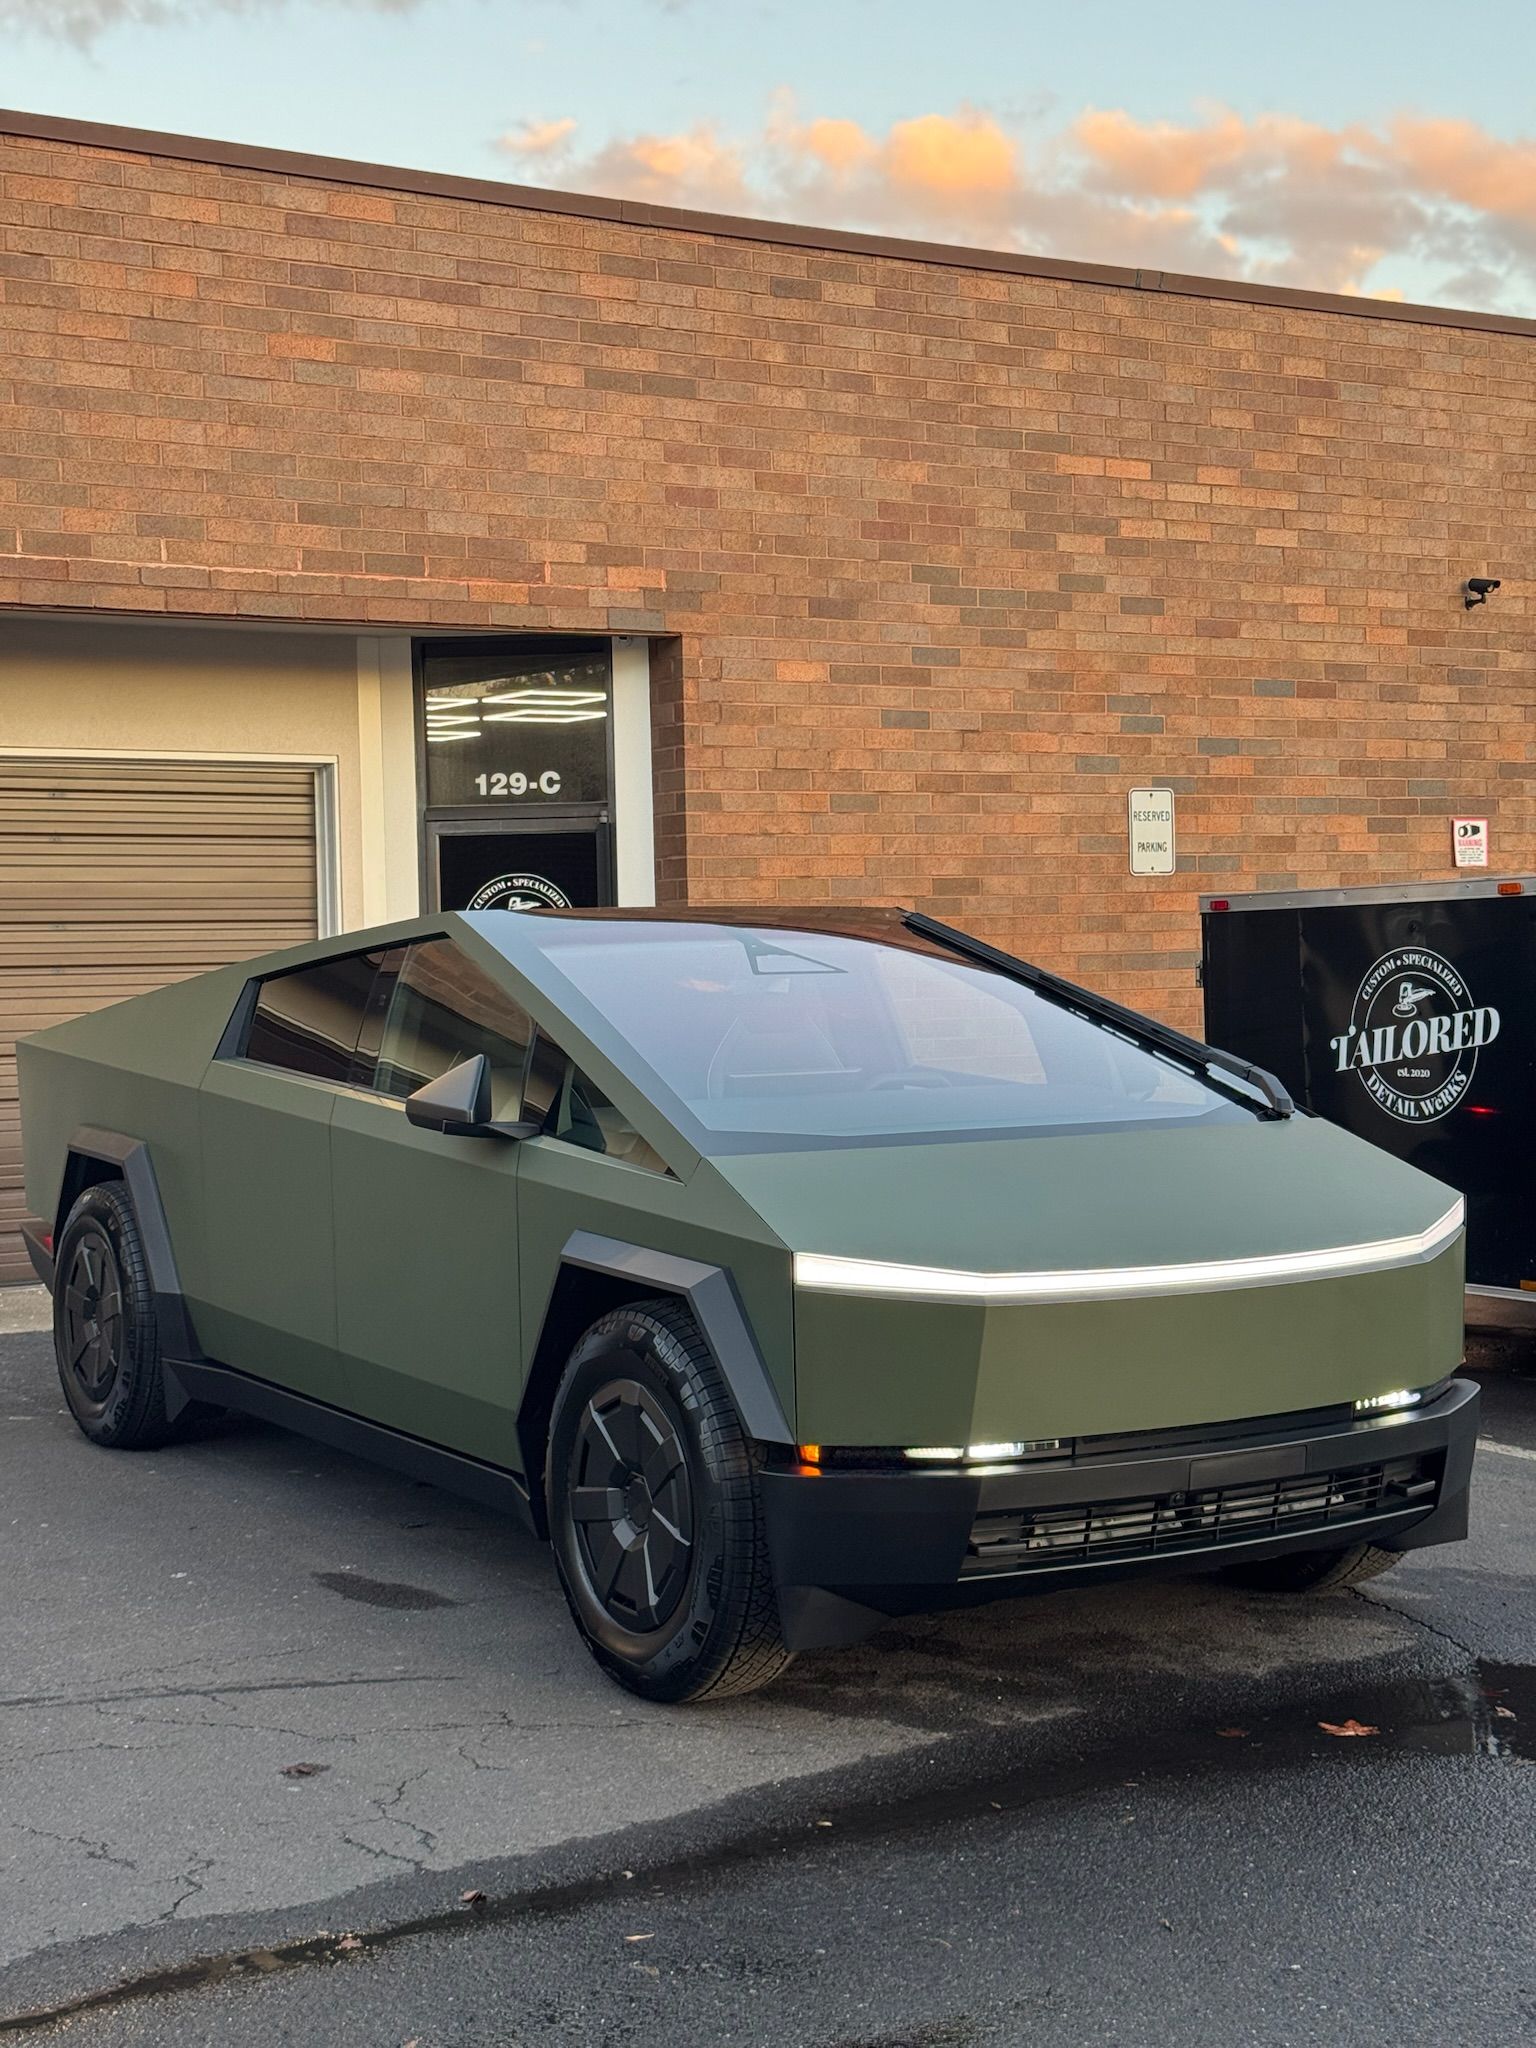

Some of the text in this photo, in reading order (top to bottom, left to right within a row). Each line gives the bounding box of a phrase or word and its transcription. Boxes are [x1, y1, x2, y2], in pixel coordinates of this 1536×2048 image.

[475, 771, 561, 796] 129-C
[1133, 810, 1170, 822] RESERVED
[1137, 842, 1168, 853] PARKING
[473, 878, 565, 909] CUSTOM SPECIALIZED
[1362, 953, 1463, 1000] CUSTOM SPECIALIZED
[1330, 1006, 1500, 1072] TAILORED
[1367, 1073, 1419, 1117] DETAIL
